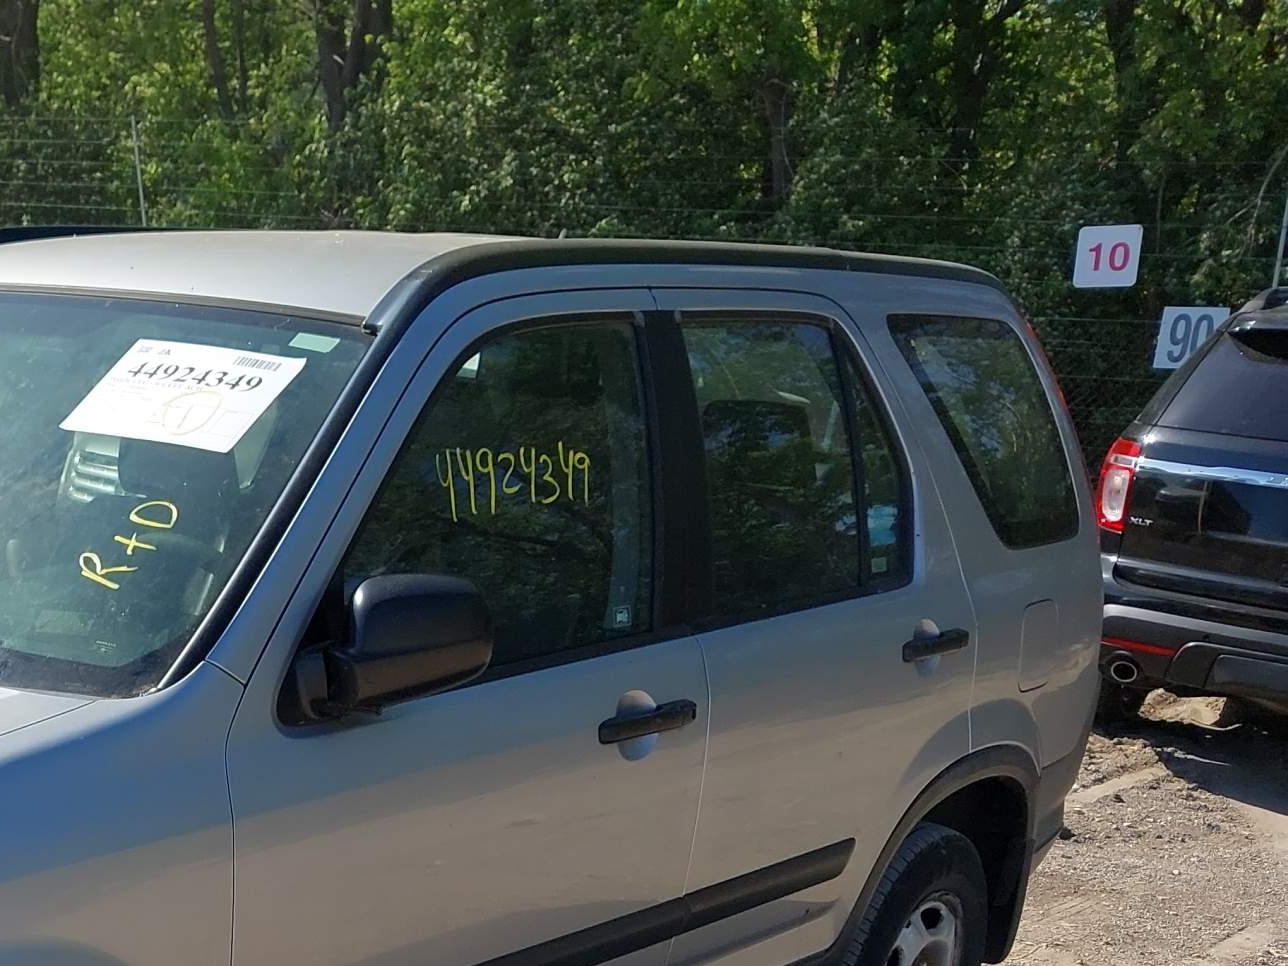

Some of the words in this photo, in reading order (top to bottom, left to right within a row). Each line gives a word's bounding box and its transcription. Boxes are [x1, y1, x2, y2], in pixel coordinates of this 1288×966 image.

[1088, 241, 1131, 272] 10
[1166, 312, 1216, 364] 90
[127, 360, 263, 393] 44924349
[435, 440, 591, 522] 44924349
[1129, 516, 1154, 527] XLT
